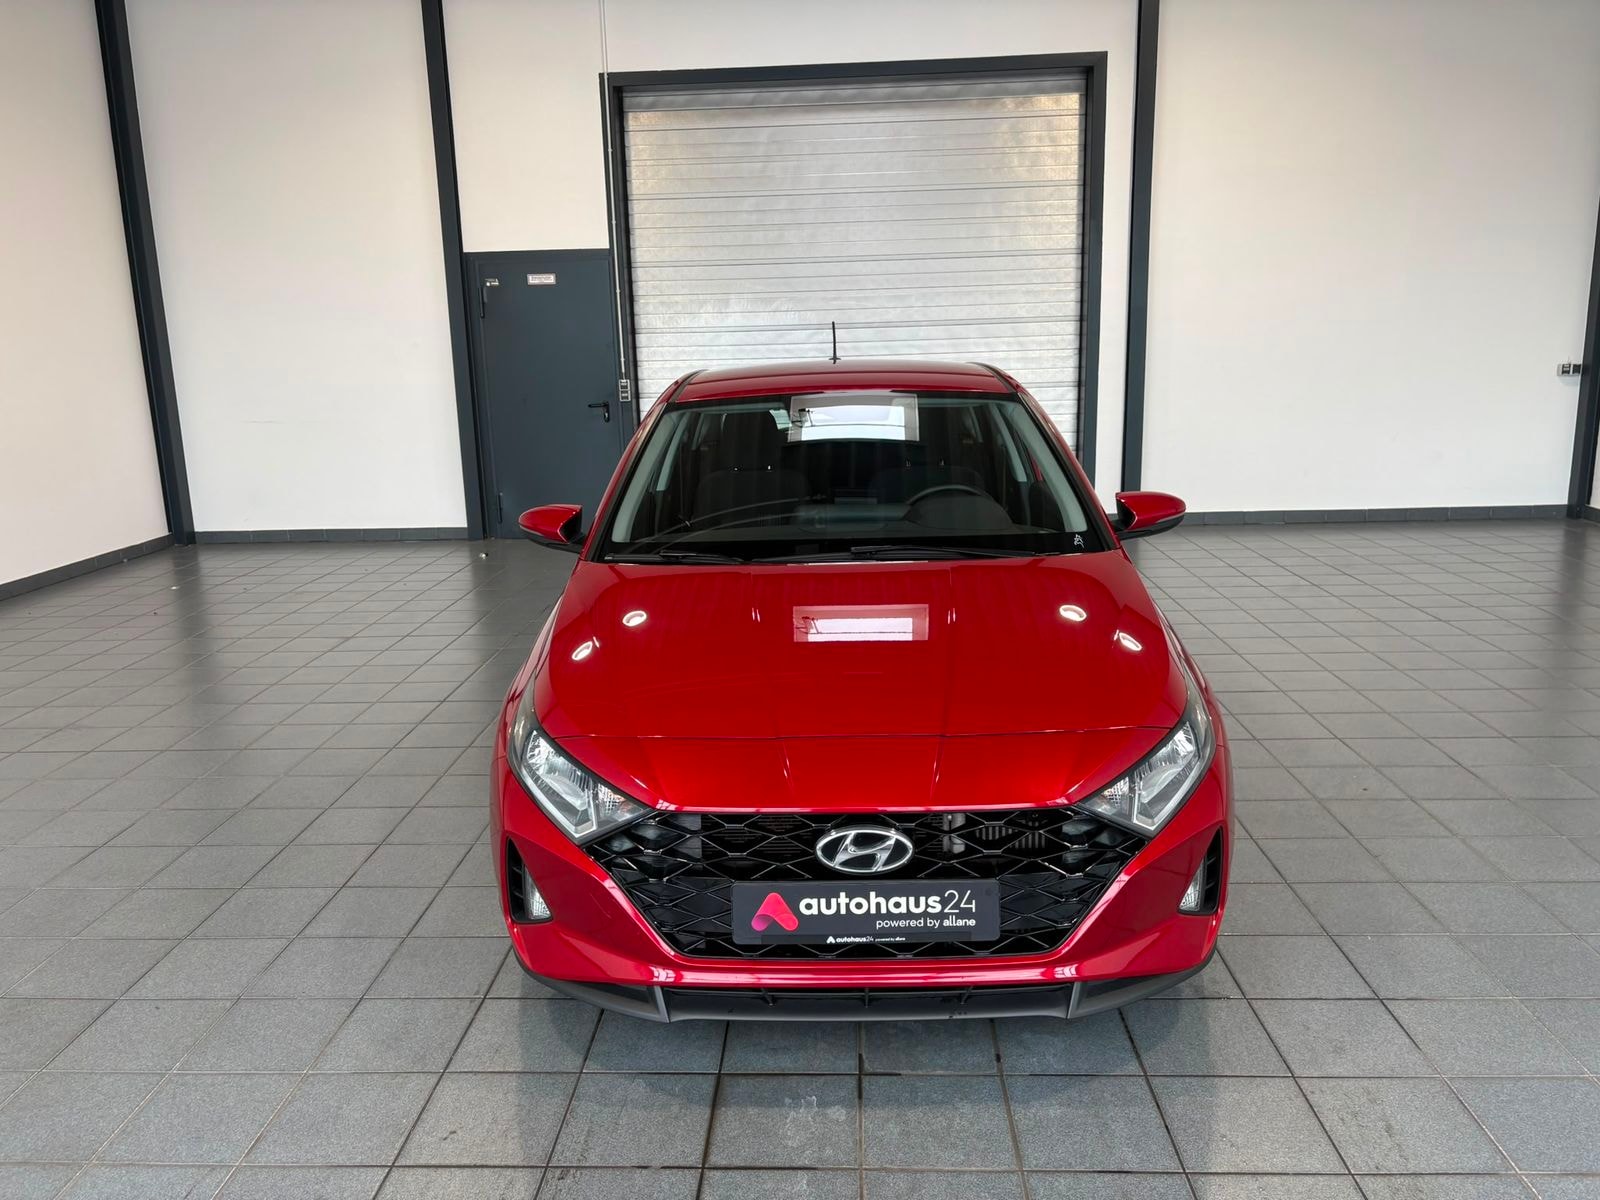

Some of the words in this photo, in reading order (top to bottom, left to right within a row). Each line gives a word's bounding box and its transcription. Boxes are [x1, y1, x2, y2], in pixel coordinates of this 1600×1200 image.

[799, 889, 976, 915] autohaus24
[876, 916, 924, 929] powered
[927, 916, 940, 929] by
[943, 916, 976, 927] allane
[836, 935, 874, 943] autohaus24
